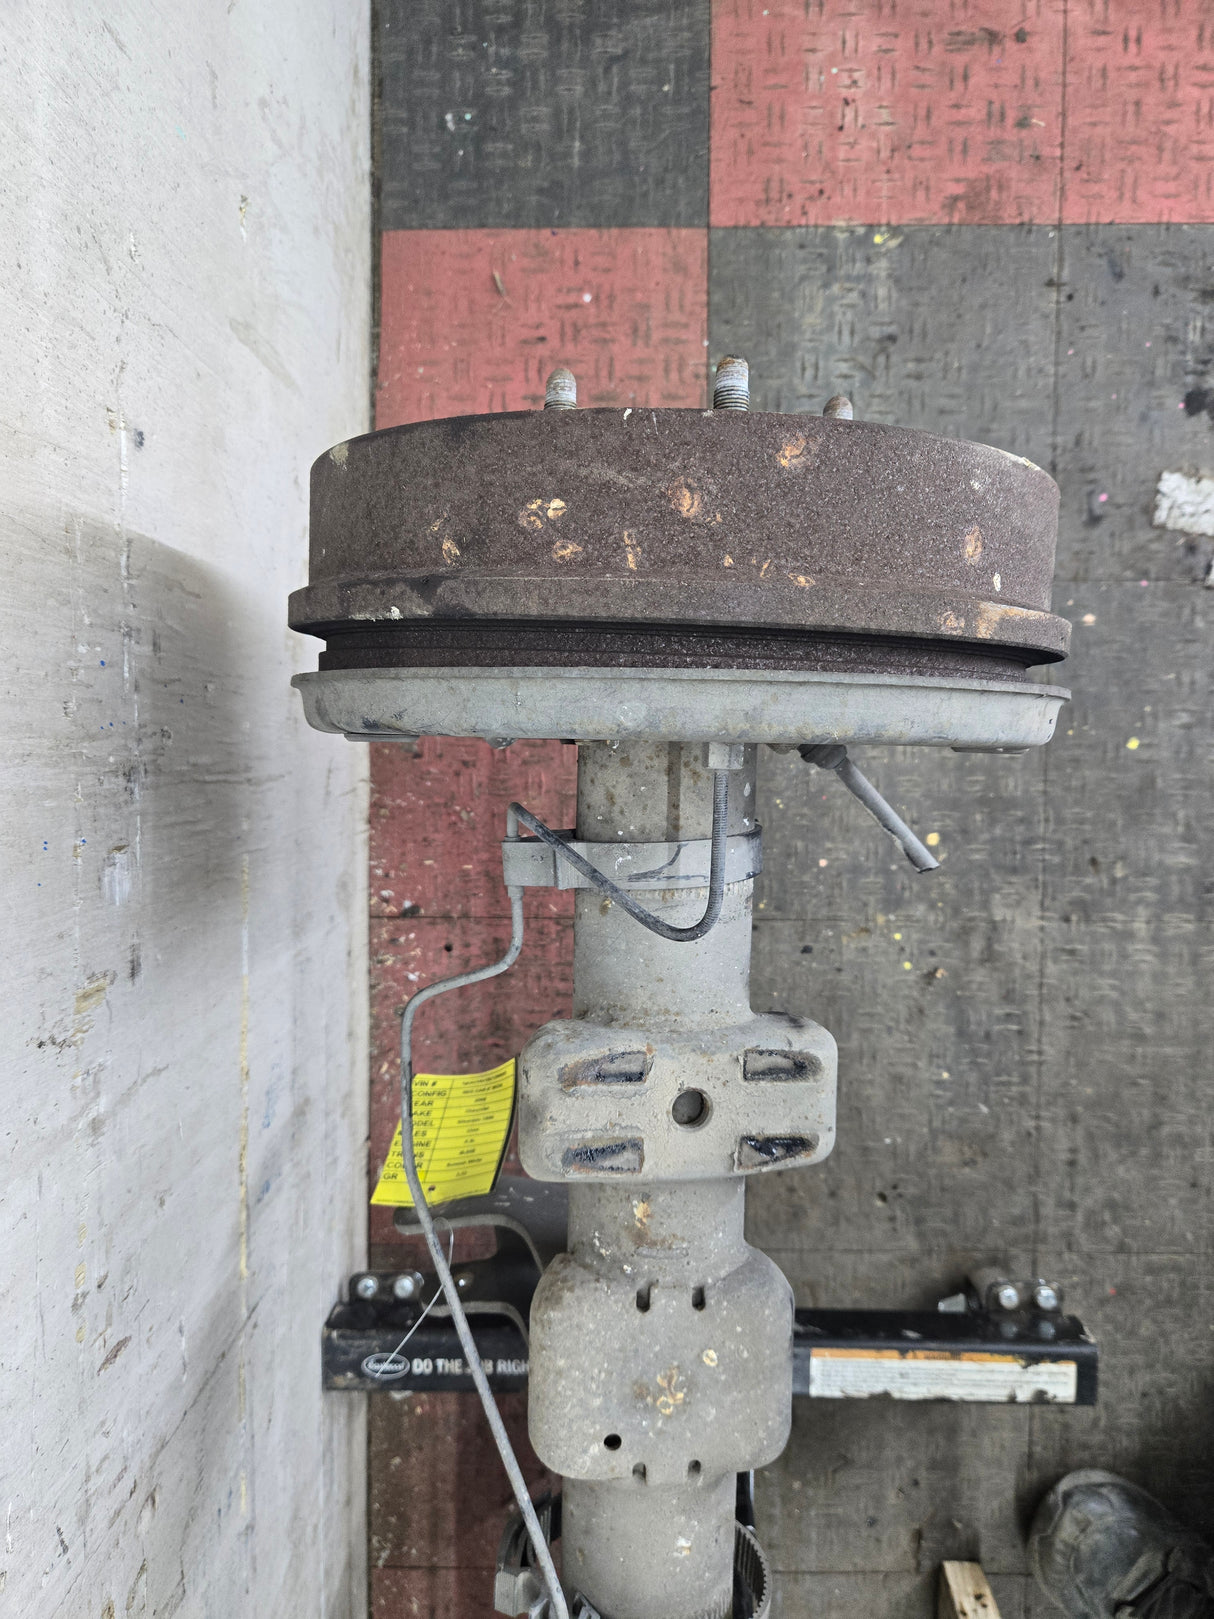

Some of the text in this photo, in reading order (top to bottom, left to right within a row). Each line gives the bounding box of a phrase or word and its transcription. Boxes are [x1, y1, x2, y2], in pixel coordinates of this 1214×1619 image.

[414, 1079, 428, 1087] VIN
[412, 1358, 433, 1375] DO
[436, 1358, 463, 1375] THE
[496, 1358, 529, 1375] RIGH
